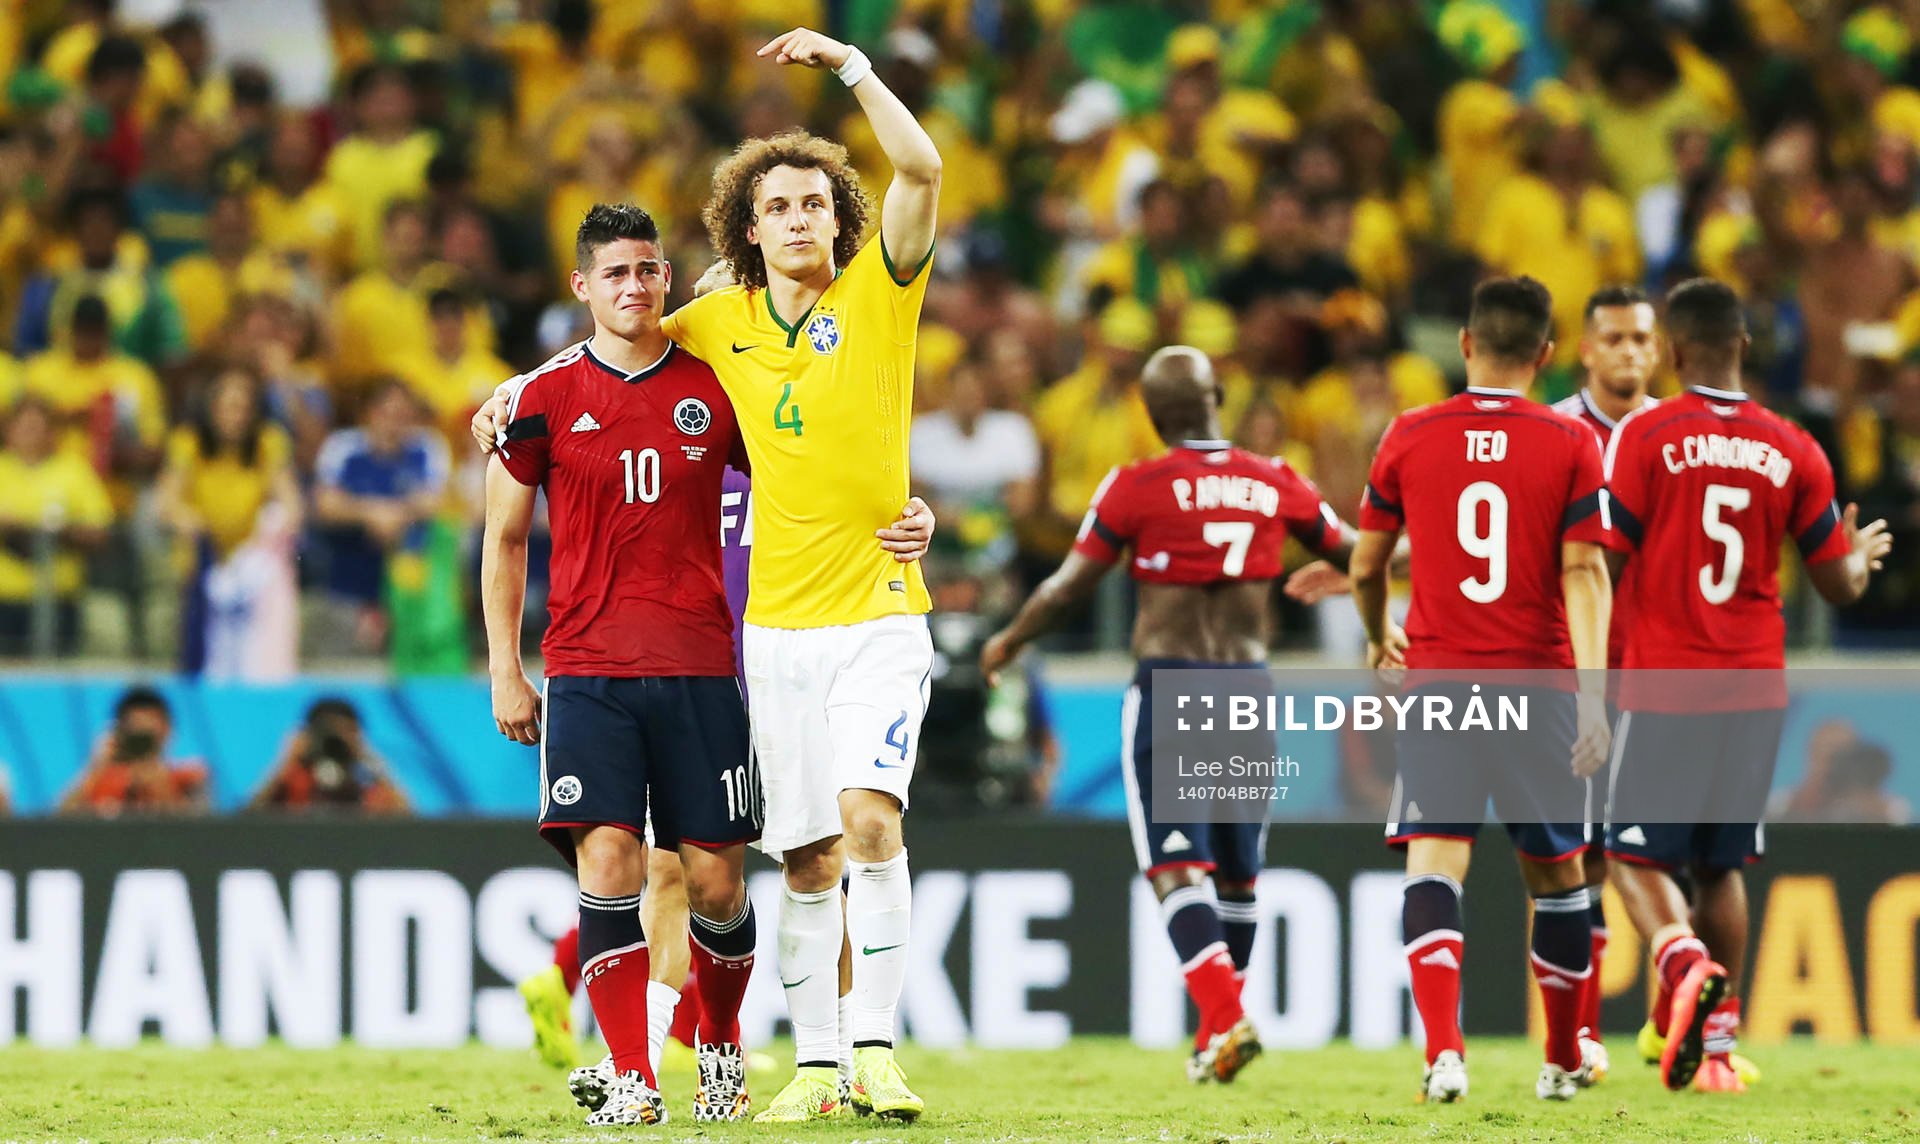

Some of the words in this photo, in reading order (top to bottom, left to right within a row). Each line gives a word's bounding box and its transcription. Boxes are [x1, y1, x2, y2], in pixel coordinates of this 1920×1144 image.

[773, 383, 804, 437] 4
[1464, 429, 1509, 463] TEO
[618, 448, 661, 504] 10
[1203, 521, 1255, 577] 7
[1457, 480, 1509, 604] 9
[1698, 483, 1751, 605] 5
[885, 709, 908, 761] 4
[720, 765, 748, 821] 10
[585, 958, 621, 986] FCF
